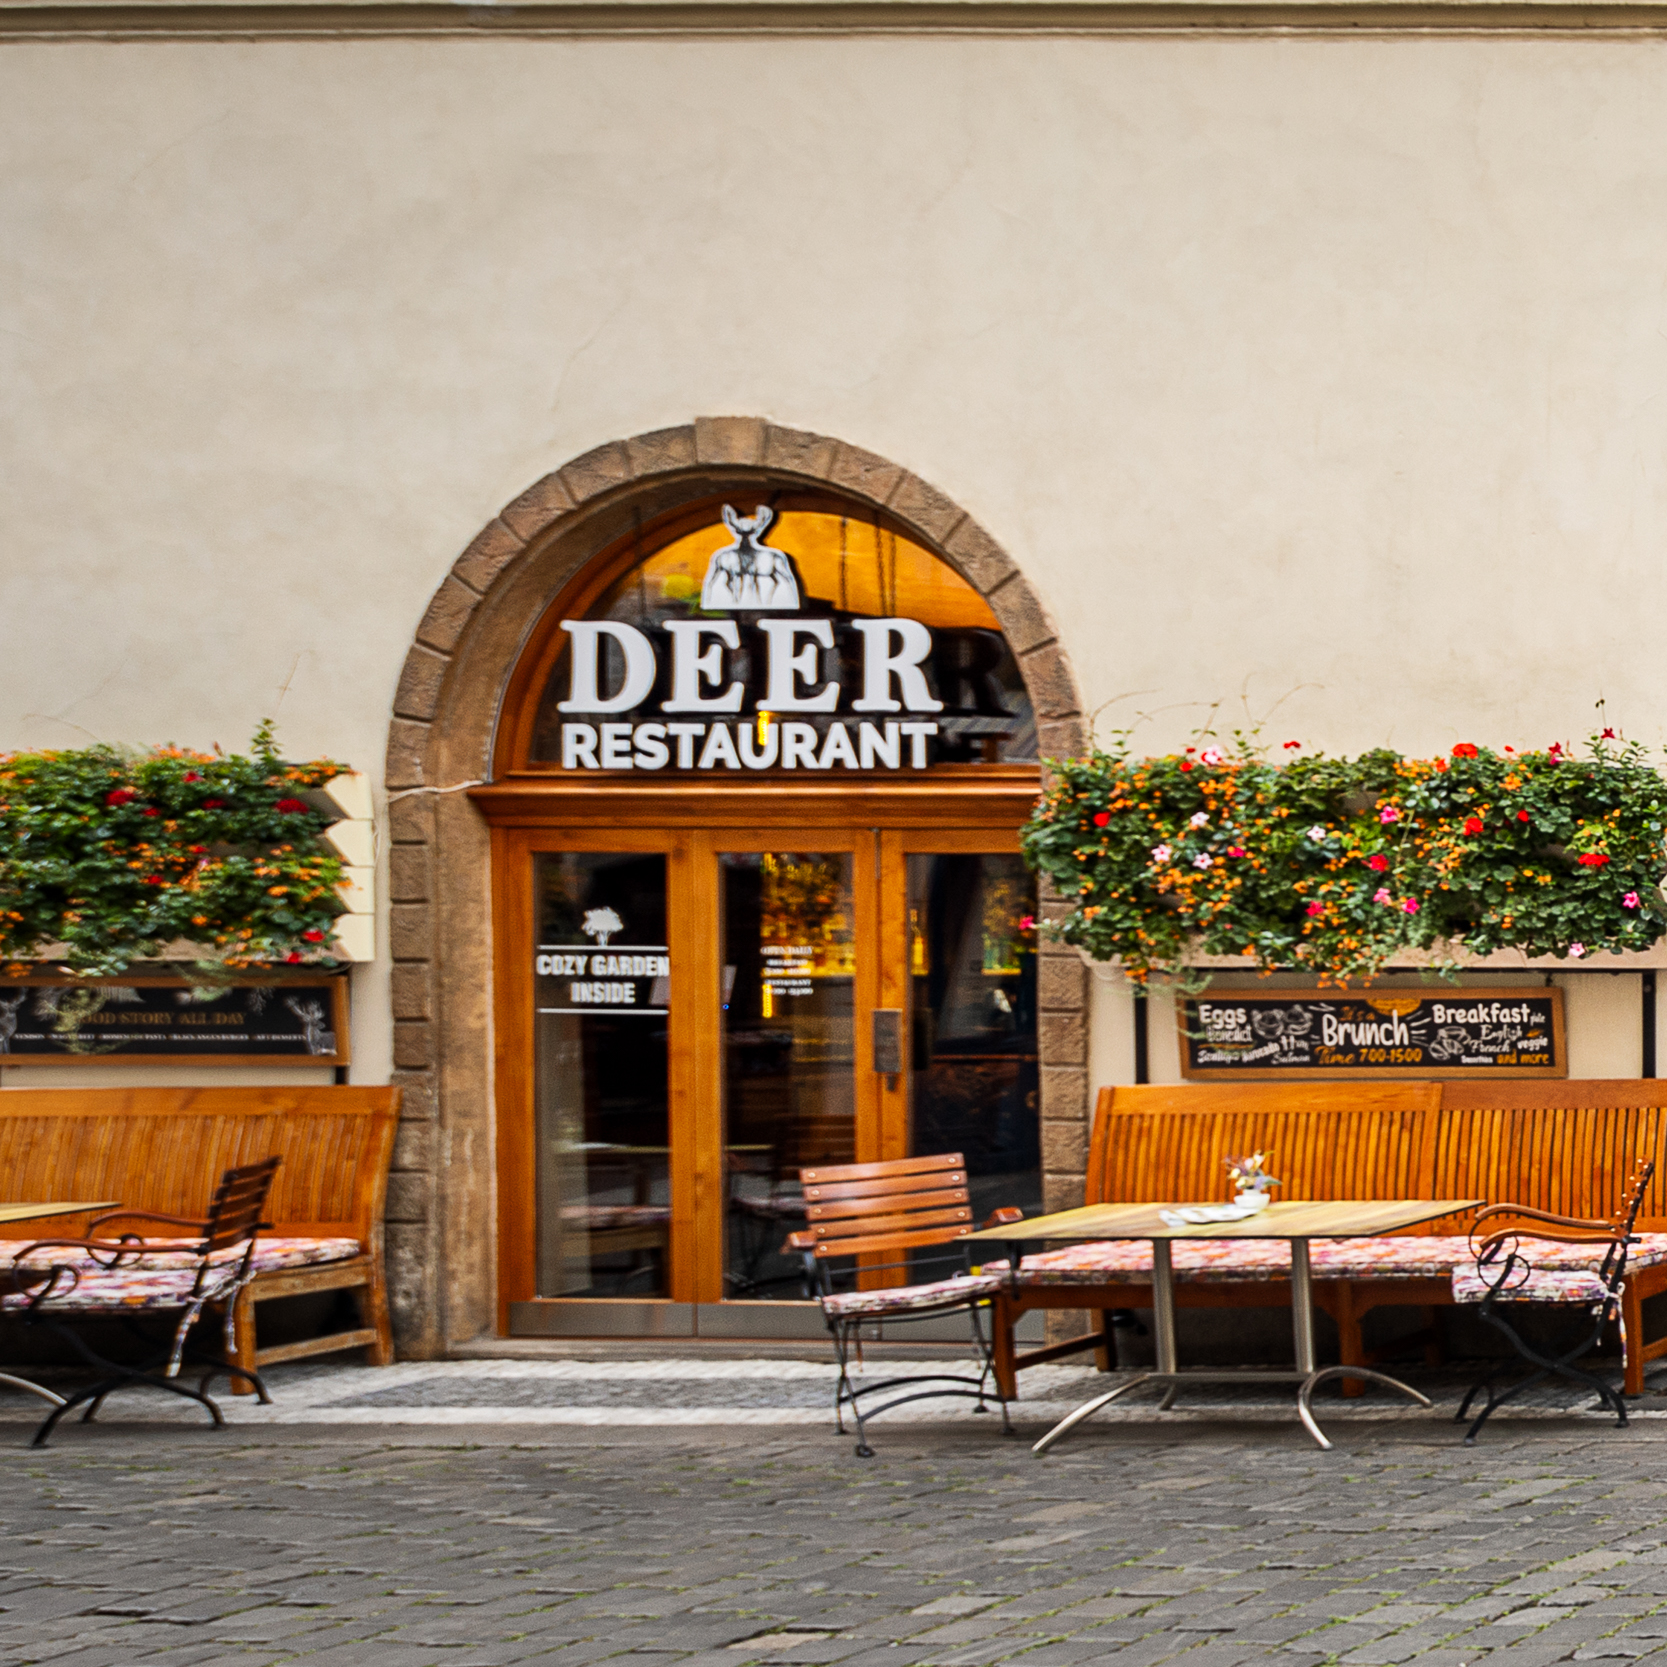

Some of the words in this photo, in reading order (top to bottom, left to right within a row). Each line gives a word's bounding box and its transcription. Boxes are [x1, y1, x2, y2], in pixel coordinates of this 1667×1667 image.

[557, 618, 943, 713] DEER
[562, 722, 938, 770] RESTAURANT
[536, 954, 587, 976] COZY
[591, 955, 669, 977] GARDEN
[570, 982, 636, 1003] INSIDE
[120, 1012, 173, 1025] STORY
[214, 1012, 246, 1025] DAY
[1198, 1004, 1247, 1029] Eggs
[1432, 1003, 1531, 1024] Breakfast
[1322, 1009, 1409, 1046] Brunch
[1496, 1048, 1518, 1064] and
[1520, 1053, 1550, 1064] more
